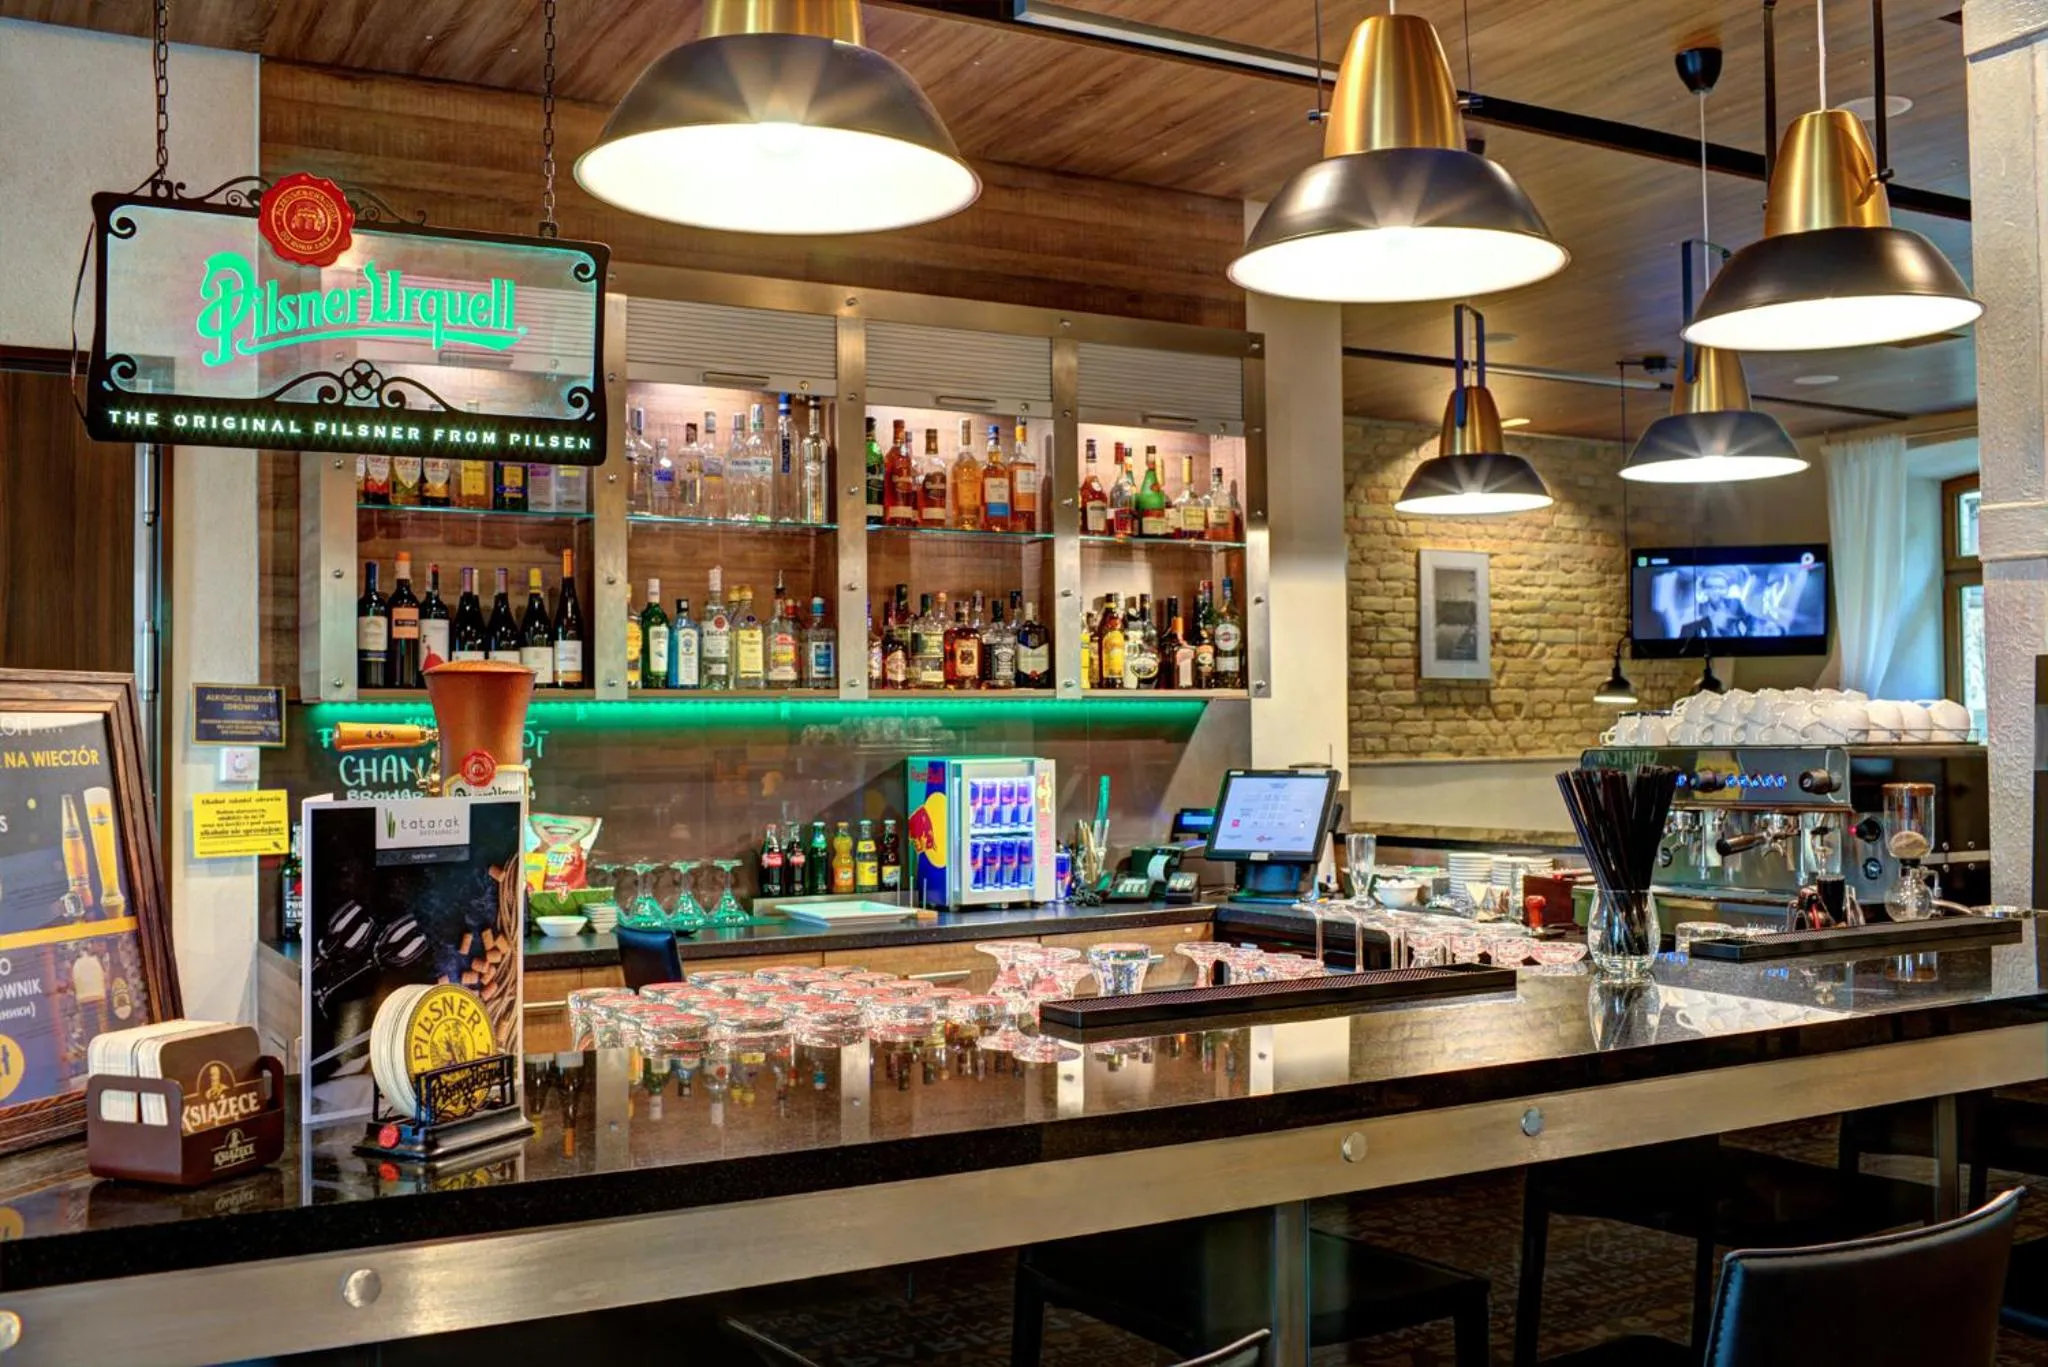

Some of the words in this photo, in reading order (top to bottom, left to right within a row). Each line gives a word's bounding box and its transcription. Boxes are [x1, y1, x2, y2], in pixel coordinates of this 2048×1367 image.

[197, 252, 368, 367] Pilsner
[364, 261, 516, 350] Urquell
[109, 410, 158, 426] THE
[174, 414, 301, 433] ORIGINAL
[314, 421, 419, 440] PILSNER
[434, 428, 496, 444] FROM
[510, 433, 590, 449] PILSEN
[4, 751, 29, 768] NA
[31, 744, 100, 767] WIECZÓR
[401, 816, 460, 830] tatarak
[413, 995, 482, 1062] PILSNER
[182, 1091, 261, 1133] KSIĄŻĘCE
